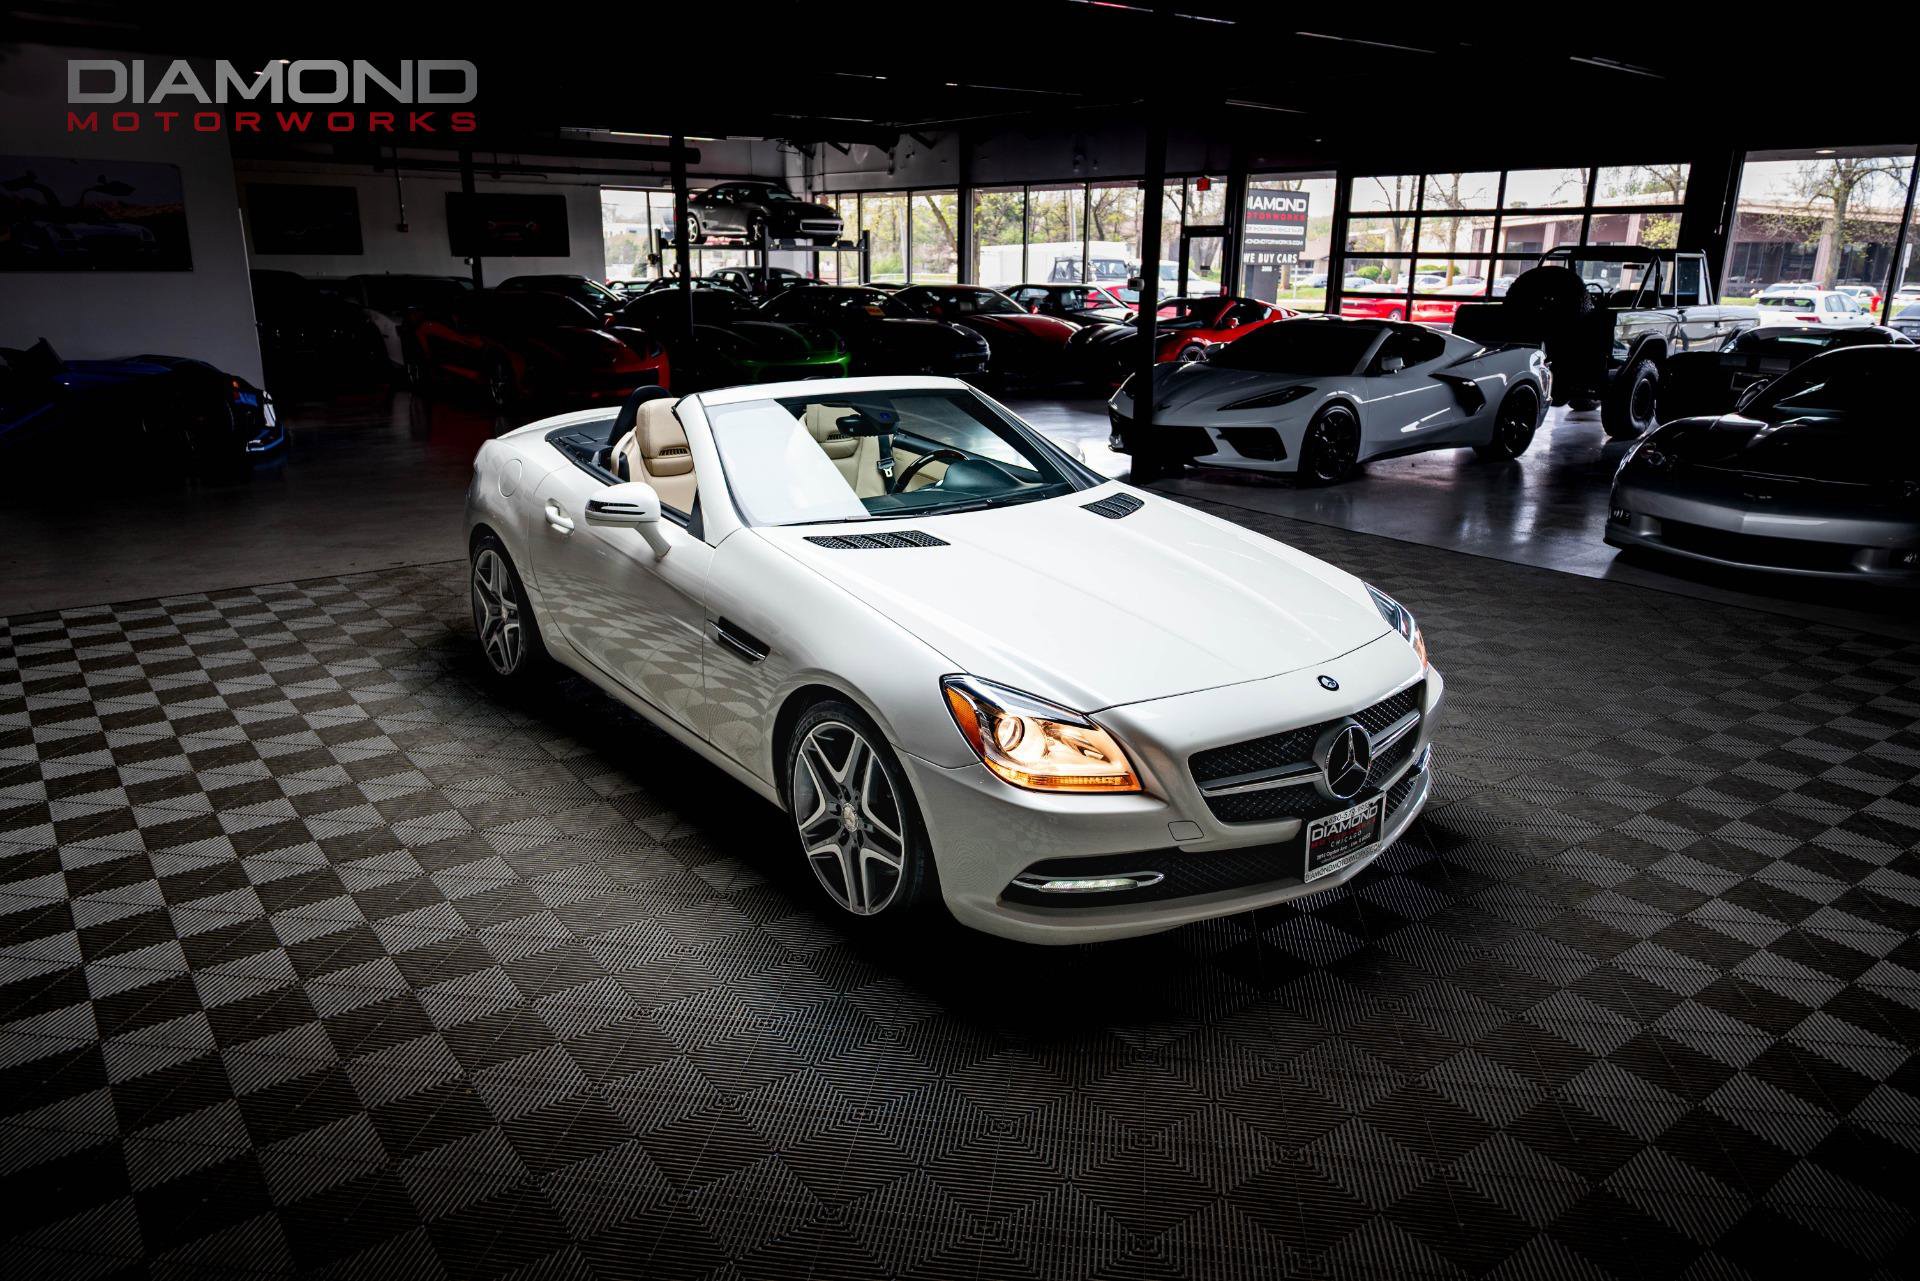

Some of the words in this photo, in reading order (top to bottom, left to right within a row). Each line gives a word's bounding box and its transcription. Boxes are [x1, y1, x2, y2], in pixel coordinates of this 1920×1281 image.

[1243, 252, 1255, 263] WE
[1258, 253, 1274, 263] BUY
[1277, 253, 1298, 264] CARS
[1311, 805, 1378, 842] DIAMOND
[1330, 830, 1362, 847] CHICAGO
